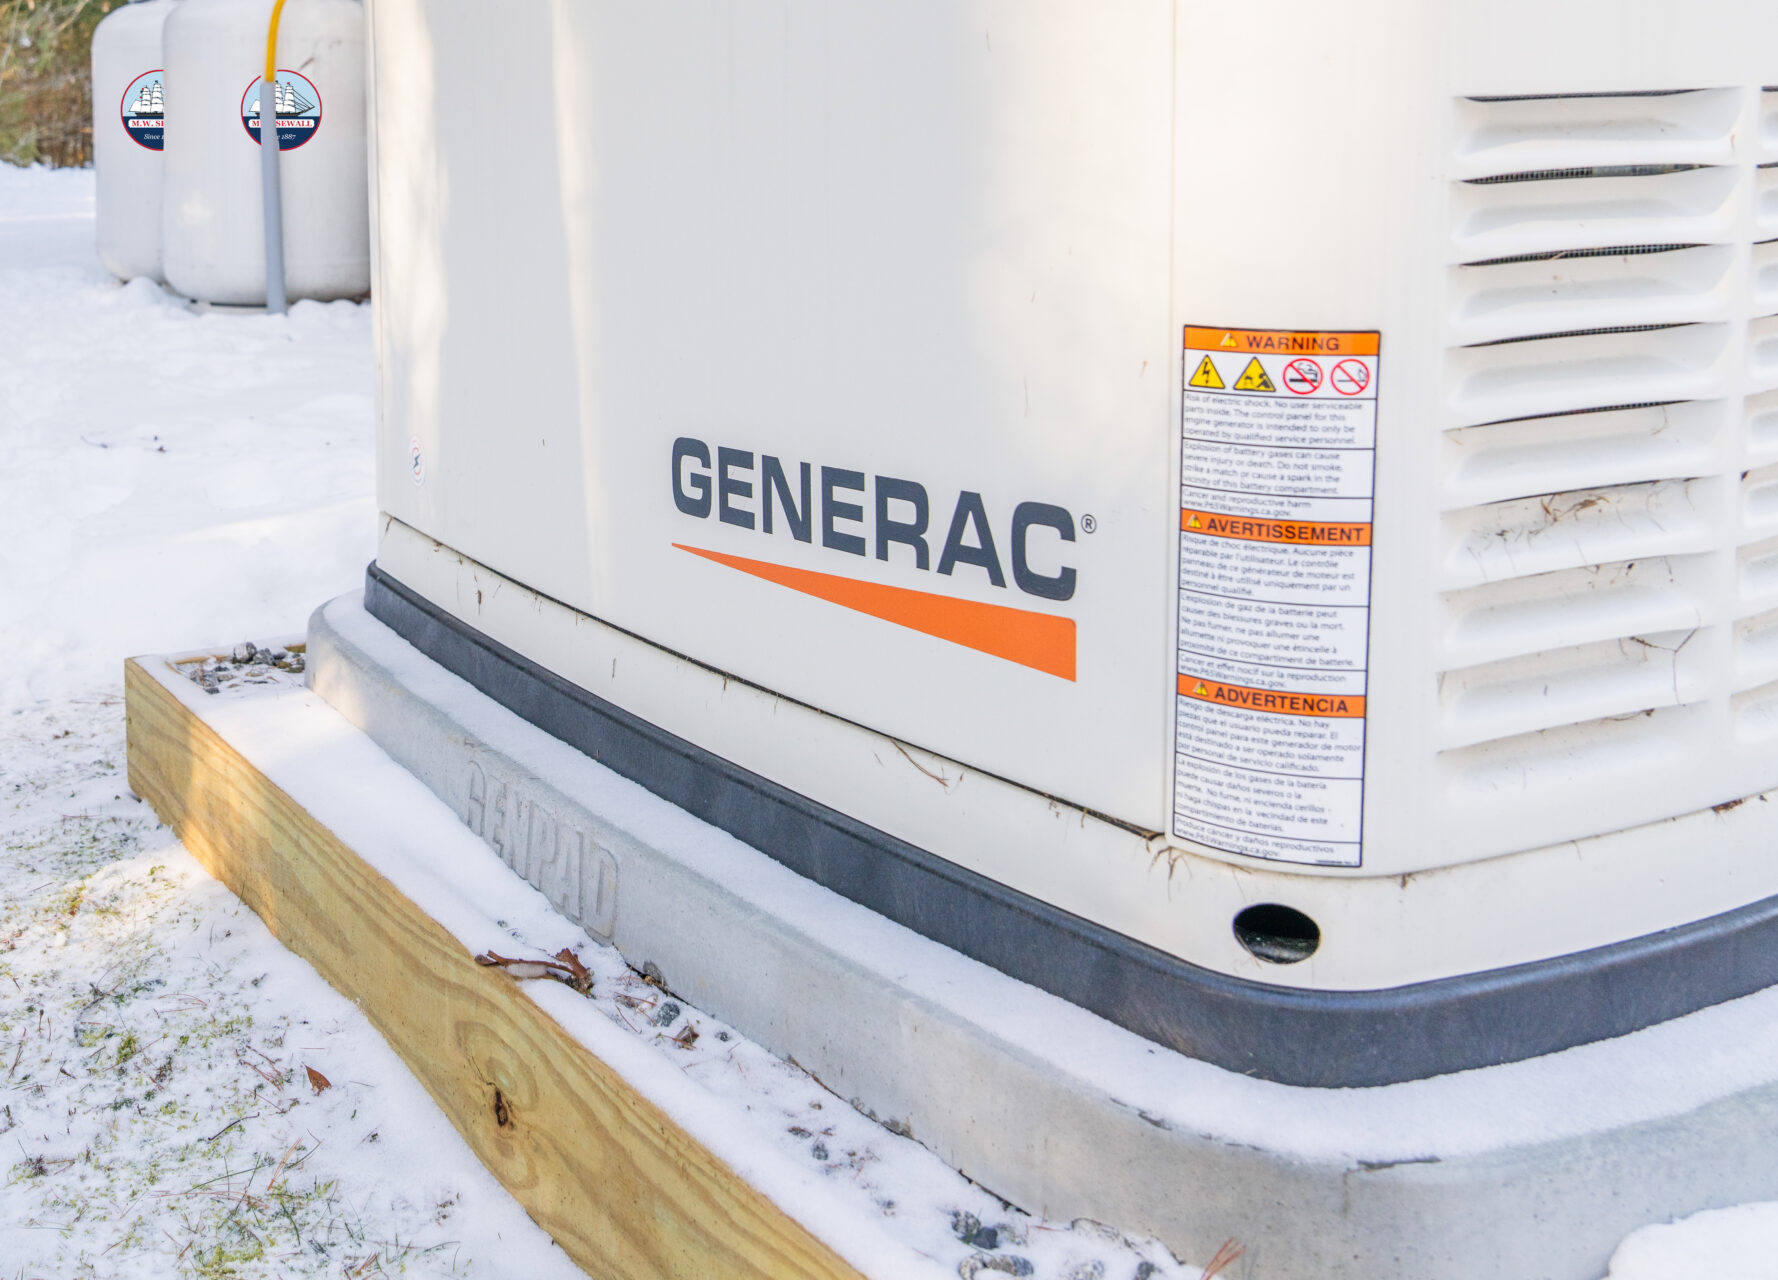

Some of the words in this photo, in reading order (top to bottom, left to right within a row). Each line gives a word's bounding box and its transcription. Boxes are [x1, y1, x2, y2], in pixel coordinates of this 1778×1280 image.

[1246, 335, 1340, 351] WARNING
[1234, 409, 1248, 417] The
[1252, 411, 1283, 419] control
[1286, 412, 1311, 421] panel
[1329, 413, 1344, 421] this
[1213, 420, 1253, 429] generator
[1266, 422, 1307, 431] intended
[1322, 425, 1340, 434] only
[1234, 432, 1271, 441] qualified
[1275, 435, 1306, 443] service
[1233, 446, 1264, 458] battery
[1287, 474, 1311, 483] spark
[1325, 474, 1339, 482] the
[1240, 481, 1270, 493] battery
[1287, 499, 1311, 508] harm
[671, 436, 1077, 602] GENERAC
[1207, 519, 1364, 541] AVERTISSEMENT
[1214, 687, 1349, 713] ADVERTENCIA
